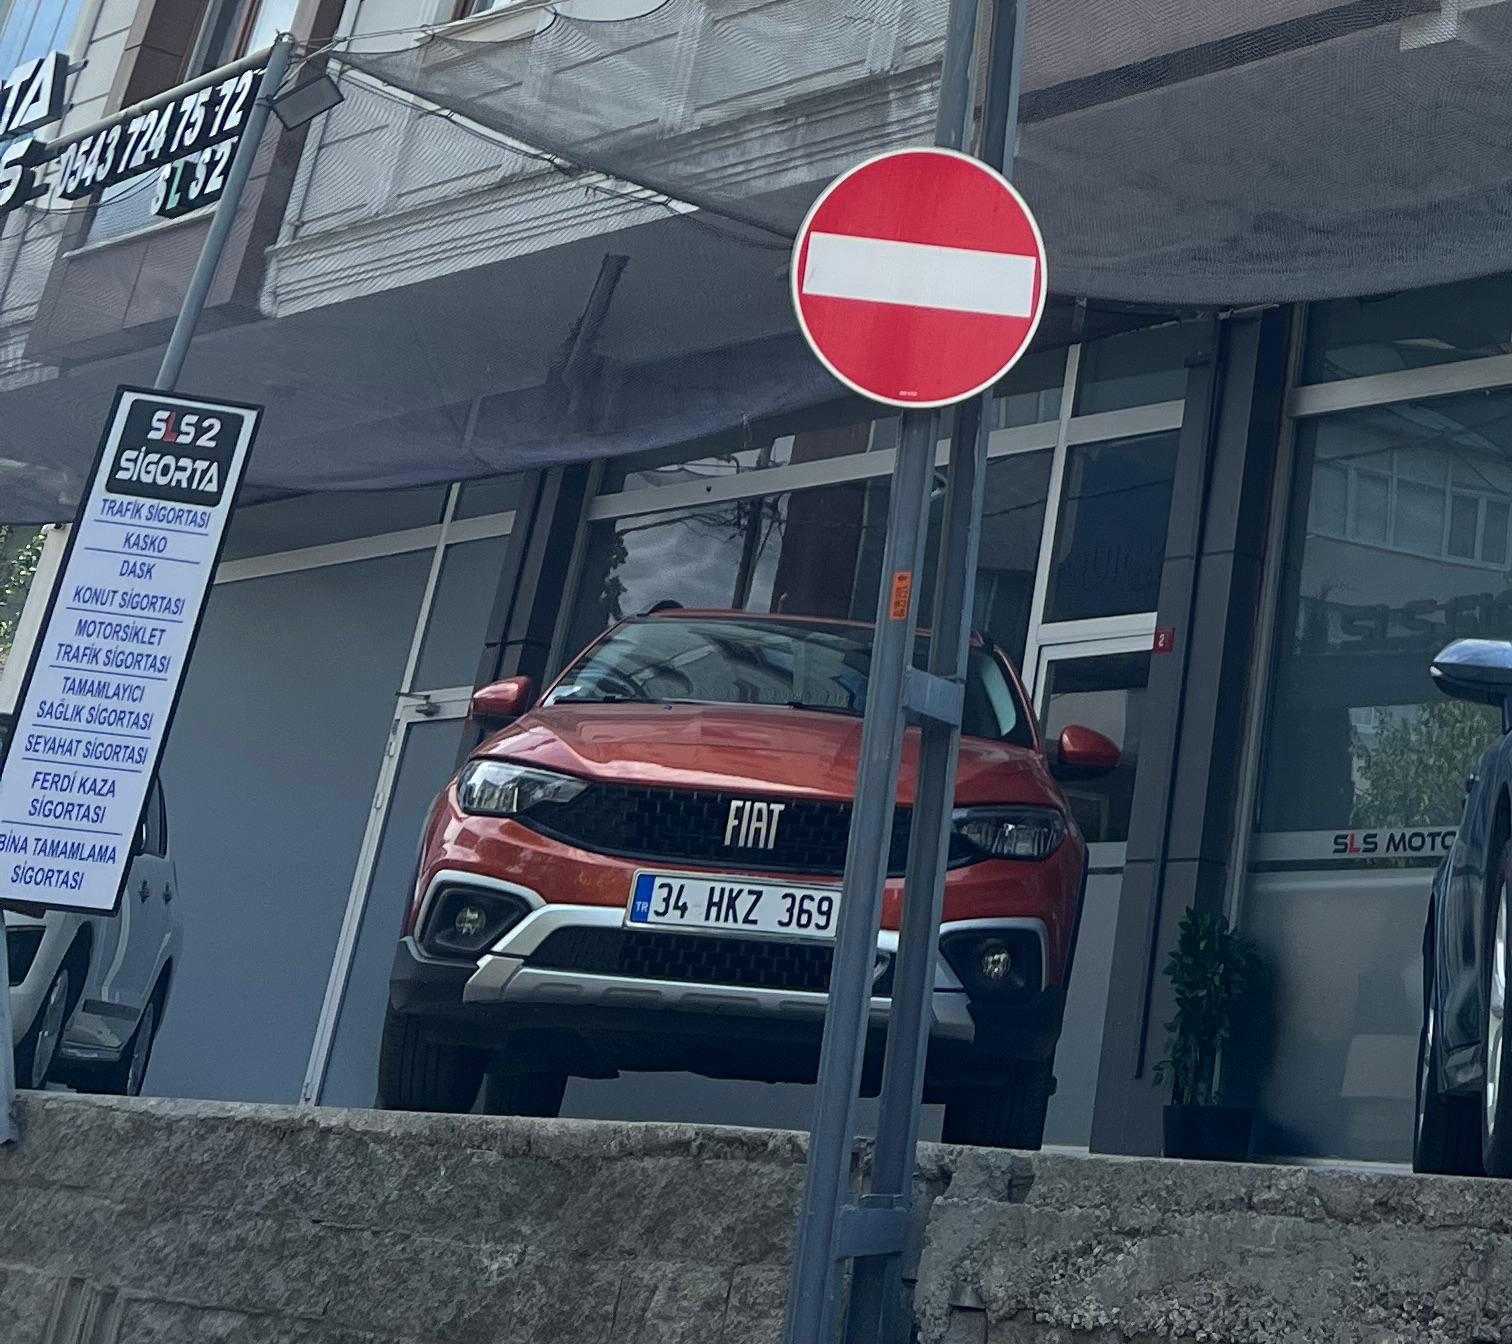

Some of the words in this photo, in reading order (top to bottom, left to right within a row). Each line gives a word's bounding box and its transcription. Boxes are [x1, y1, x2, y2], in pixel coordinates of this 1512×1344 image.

[56, 123, 122, 198] 0543
[117, 101, 176, 174] 724
[170, 86, 214, 153] 75
[209, 69, 254, 138] 72
[115, 446, 219, 493] SİGORTA
[100, 498, 145, 521] TRAFİK
[145, 502, 211, 528] SİGORTASI
[122, 531, 168, 554] KASKO
[119, 559, 157, 580] DASK
[73, 585, 119, 608] KONUT
[119, 588, 186, 616] SİGORTASI
[74, 618, 167, 646] MOTORSİKLET
[1158, 633, 1165, 647] 2
[56, 642, 101, 666] TRAFİK
[103, 645, 172, 675] SİGORTASI
[61, 676, 146, 703] TAMAMLAYICI
[36, 698, 85, 724] SAĞLIK
[86, 704, 154, 731] SİGORTASI
[24, 733, 82, 758] SEYAHAT
[82, 737, 149, 765] SİGORTASI
[30, 770, 78, 794] FERDİ
[77, 776, 116, 798] KAZA
[28, 795, 107, 824] SİGORTASI
[723, 799, 786, 850] FIAT
[32, 837, 117, 864] TAMAMLAMA
[1332, 831, 1378, 855] SLS
[10, 861, 85, 891] SİGORTASI
[635, 900, 649, 914] TR
[653, 881, 689, 919] 34
[704, 886, 764, 926] HKZ
[777, 892, 834, 931] 369
